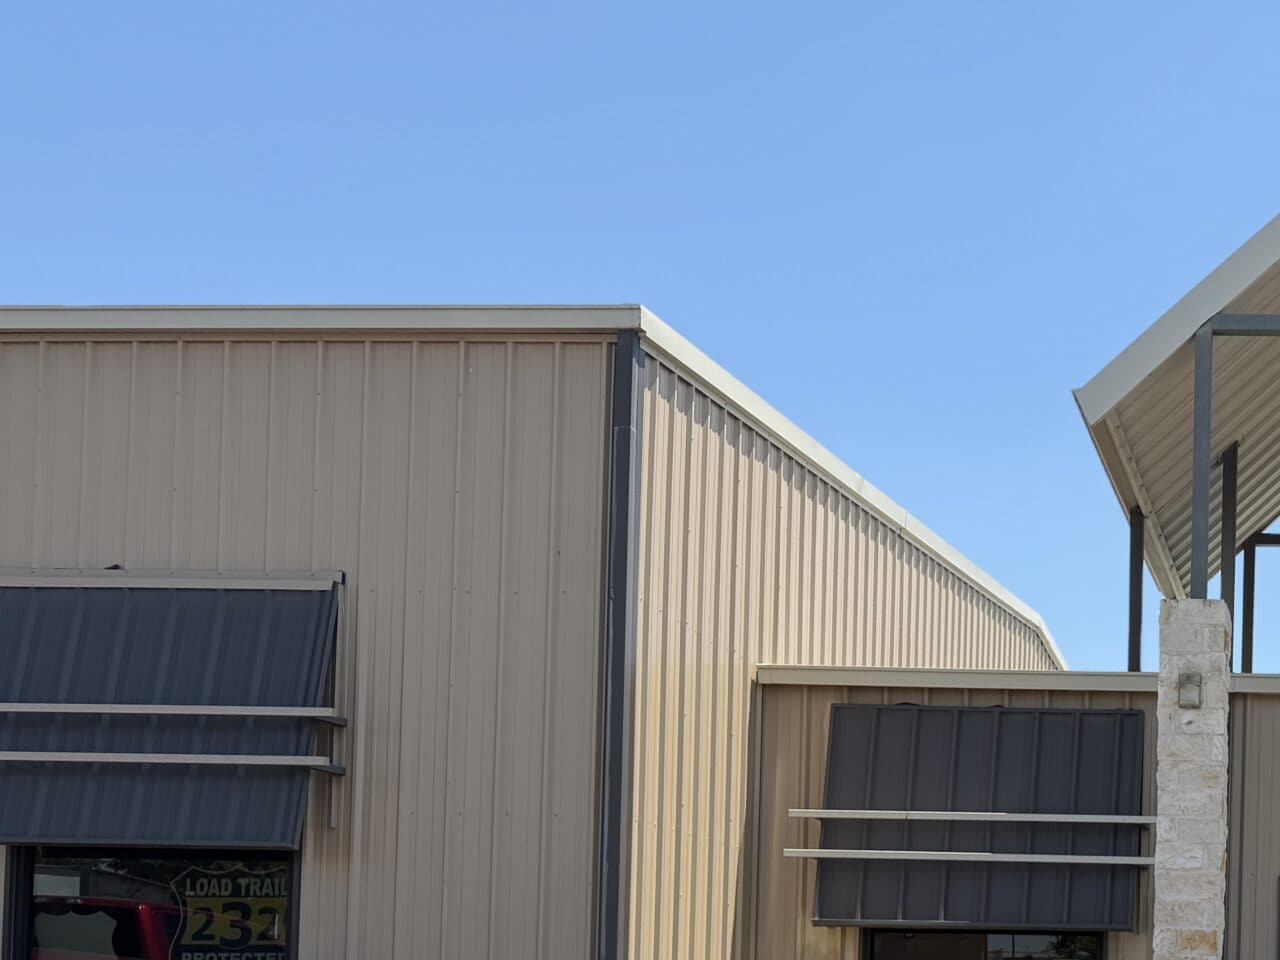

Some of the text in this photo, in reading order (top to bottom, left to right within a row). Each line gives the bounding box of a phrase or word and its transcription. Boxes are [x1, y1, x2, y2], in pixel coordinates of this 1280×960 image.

[185, 877, 287, 897] LOAD TRAIL
[191, 901, 279, 948] 232
